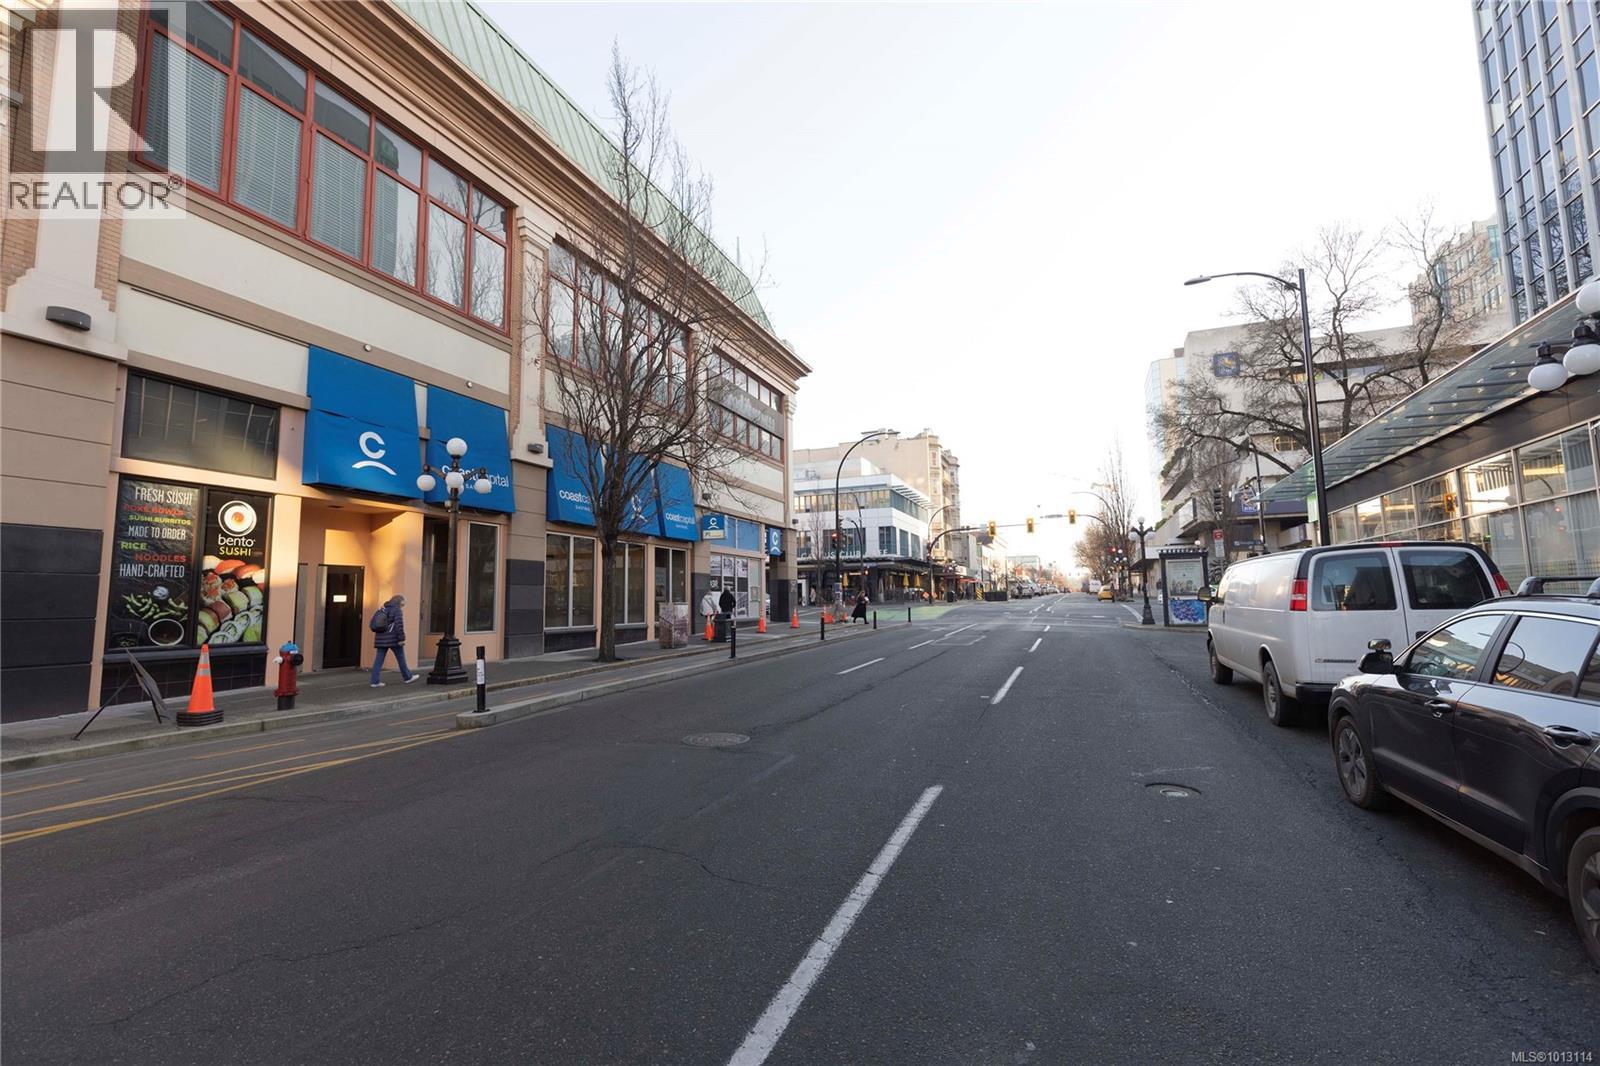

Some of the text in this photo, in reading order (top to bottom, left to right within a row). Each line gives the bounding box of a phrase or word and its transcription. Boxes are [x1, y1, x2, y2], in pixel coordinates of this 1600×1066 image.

[135, 486, 193, 506] FRESH SUSHI
[151, 506, 184, 516] BOWLS
[128, 514, 192, 525] SUSHI BURRITOS
[128, 525, 187, 541] MADE TO ORDER
[120, 540, 148, 550] RICE
[218, 533, 254, 548] bento
[219, 546, 252, 556] SUSHI
[134, 553, 187, 563] NOODLES
[119, 563, 185, 578] HAND-CRAFTED
